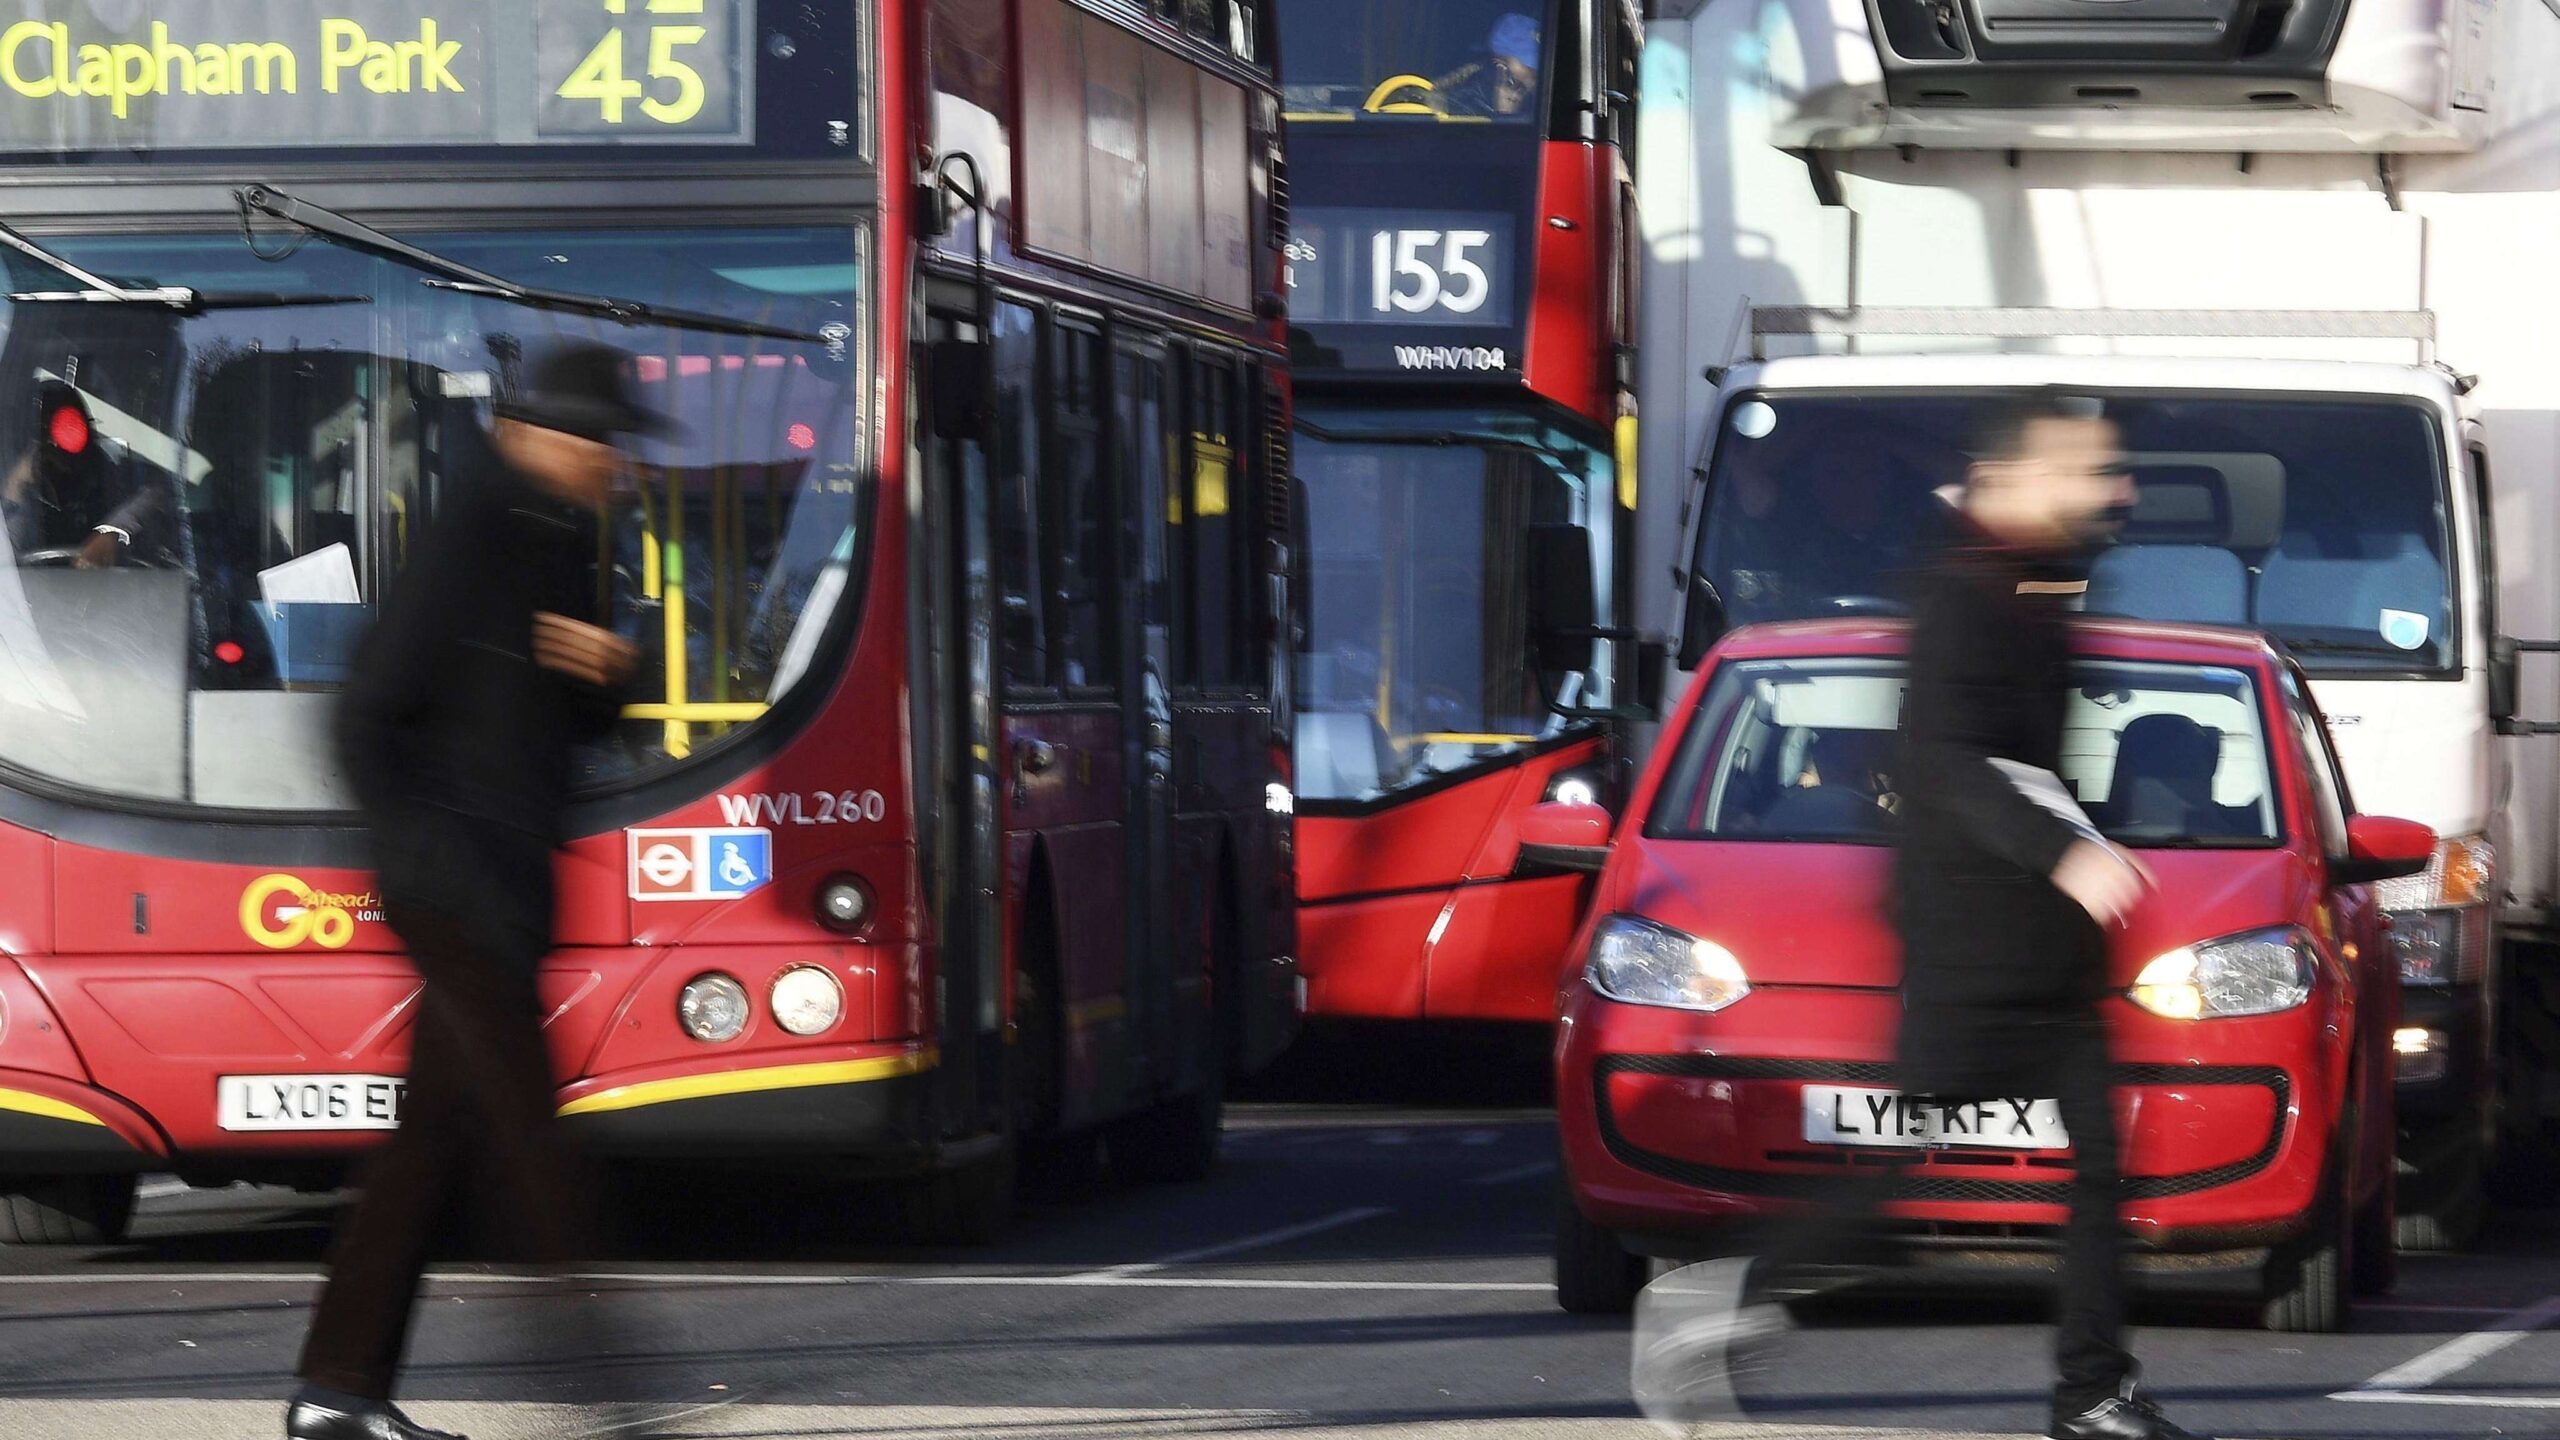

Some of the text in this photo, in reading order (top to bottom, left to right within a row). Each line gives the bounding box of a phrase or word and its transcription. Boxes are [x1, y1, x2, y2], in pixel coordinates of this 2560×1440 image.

[0, 17, 465, 119] Clapham Park
[555, 25, 707, 124] 45
[1372, 230, 1490, 313] 155
[716, 789, 886, 827] WVL260
[238, 873, 354, 949] Go
[246, 1084, 348, 1118] LX06
[1835, 1093, 2034, 1136] LY15 KFX
